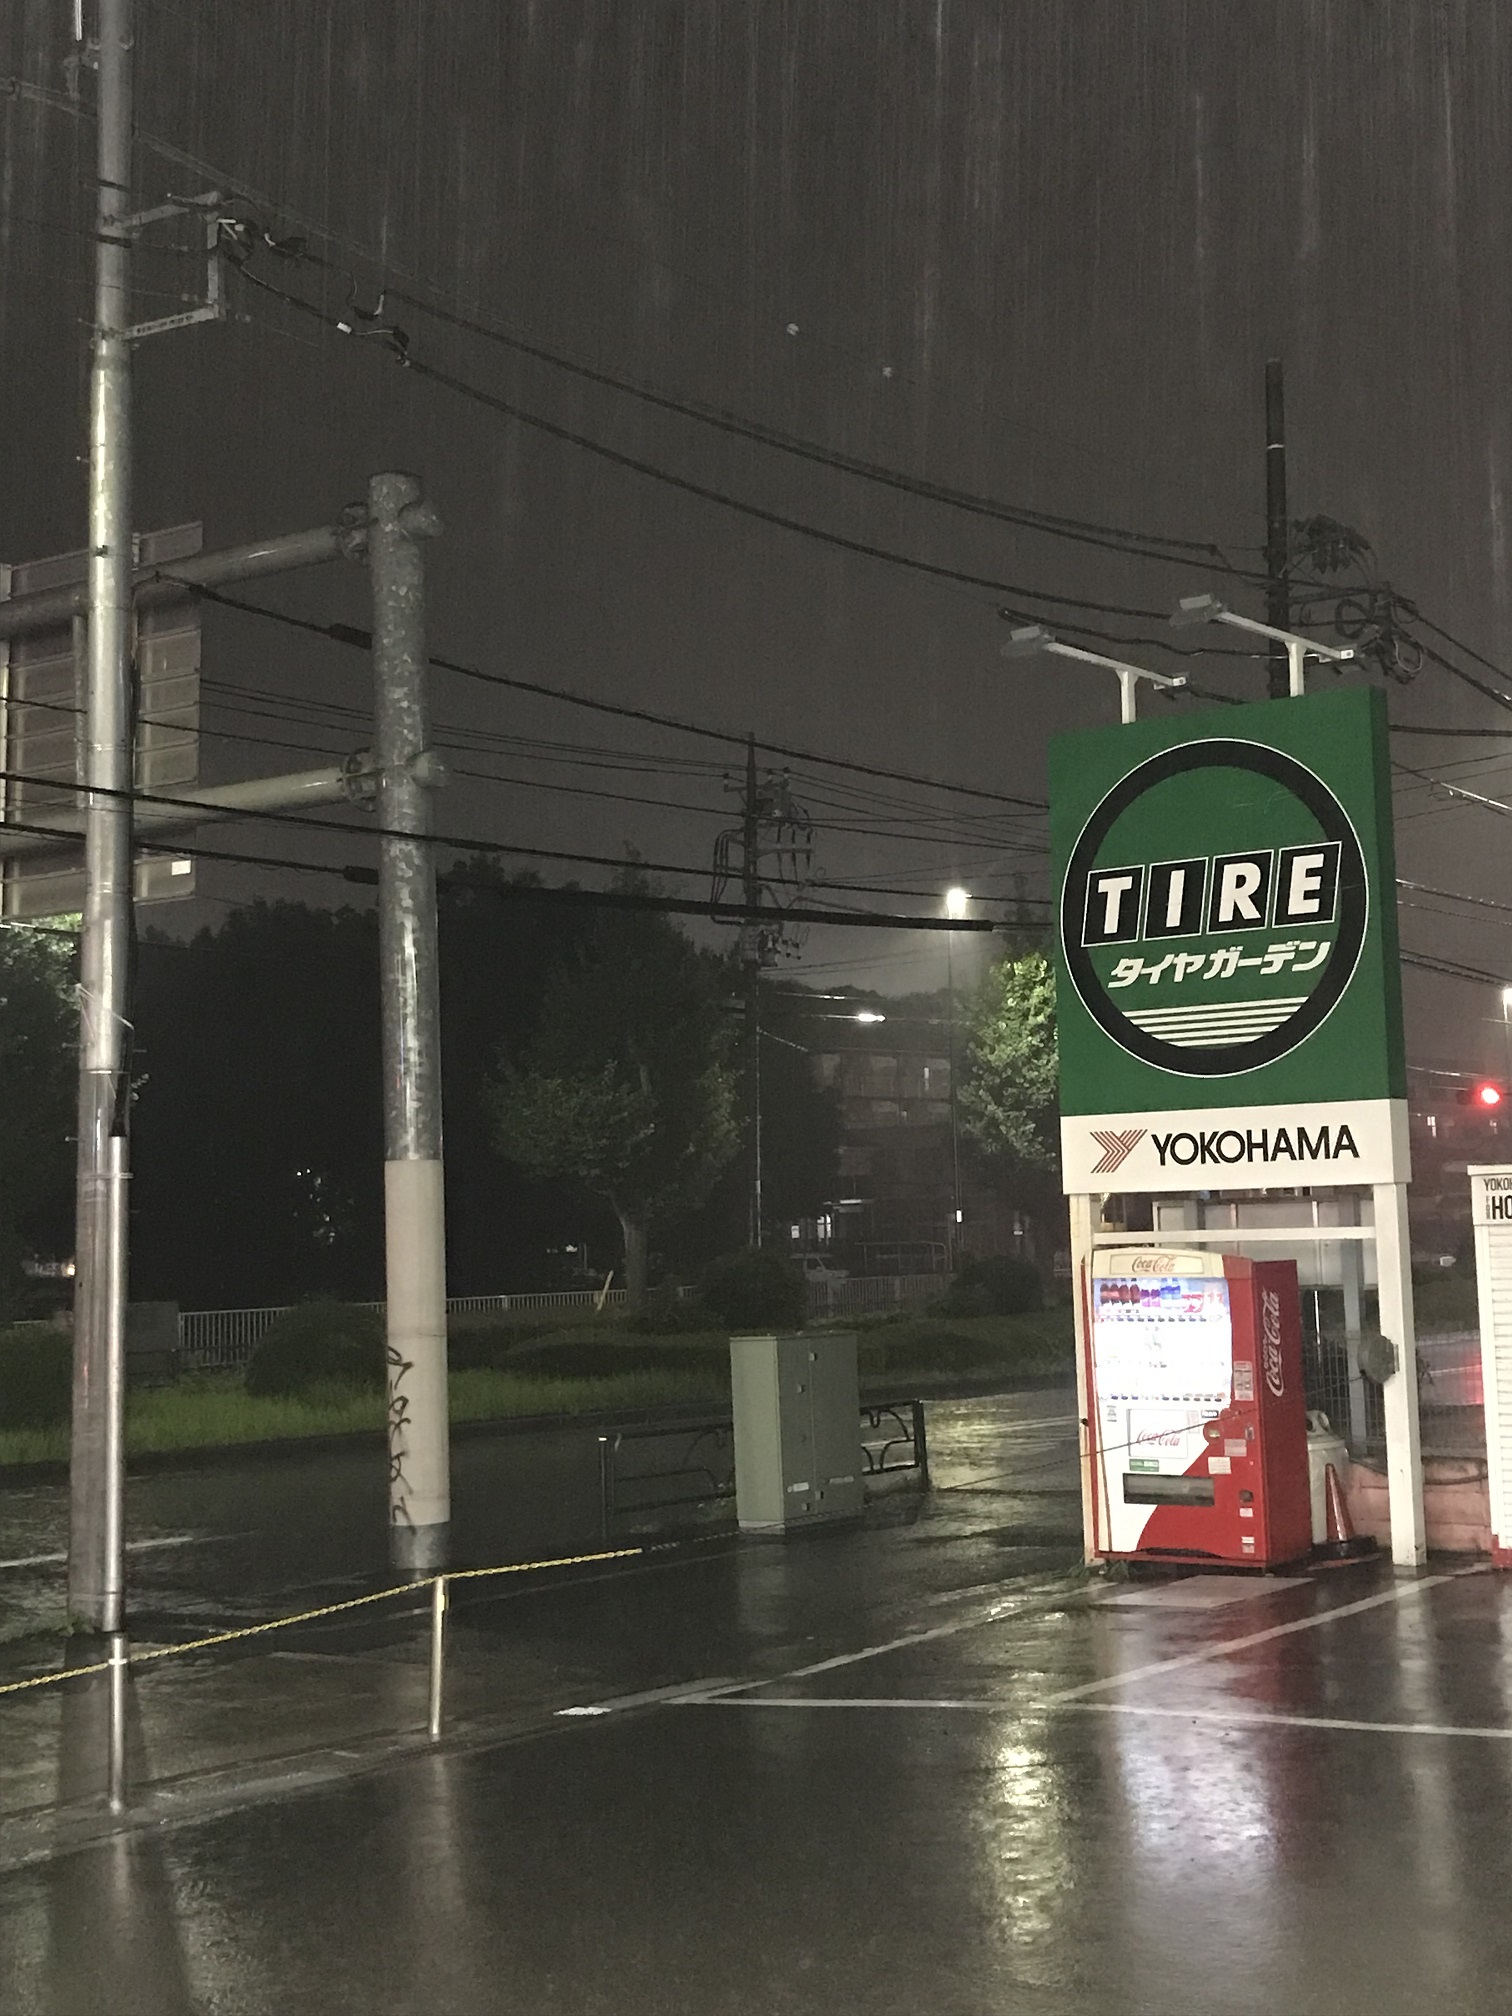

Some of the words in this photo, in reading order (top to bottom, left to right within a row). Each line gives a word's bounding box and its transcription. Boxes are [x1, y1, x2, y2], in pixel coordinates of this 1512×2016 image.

[1097, 852, 1324, 934] TIRE
[1107, 940, 1332, 988] タイヤガーデン
[1150, 1124, 1360, 1167] YOKOHAMA
